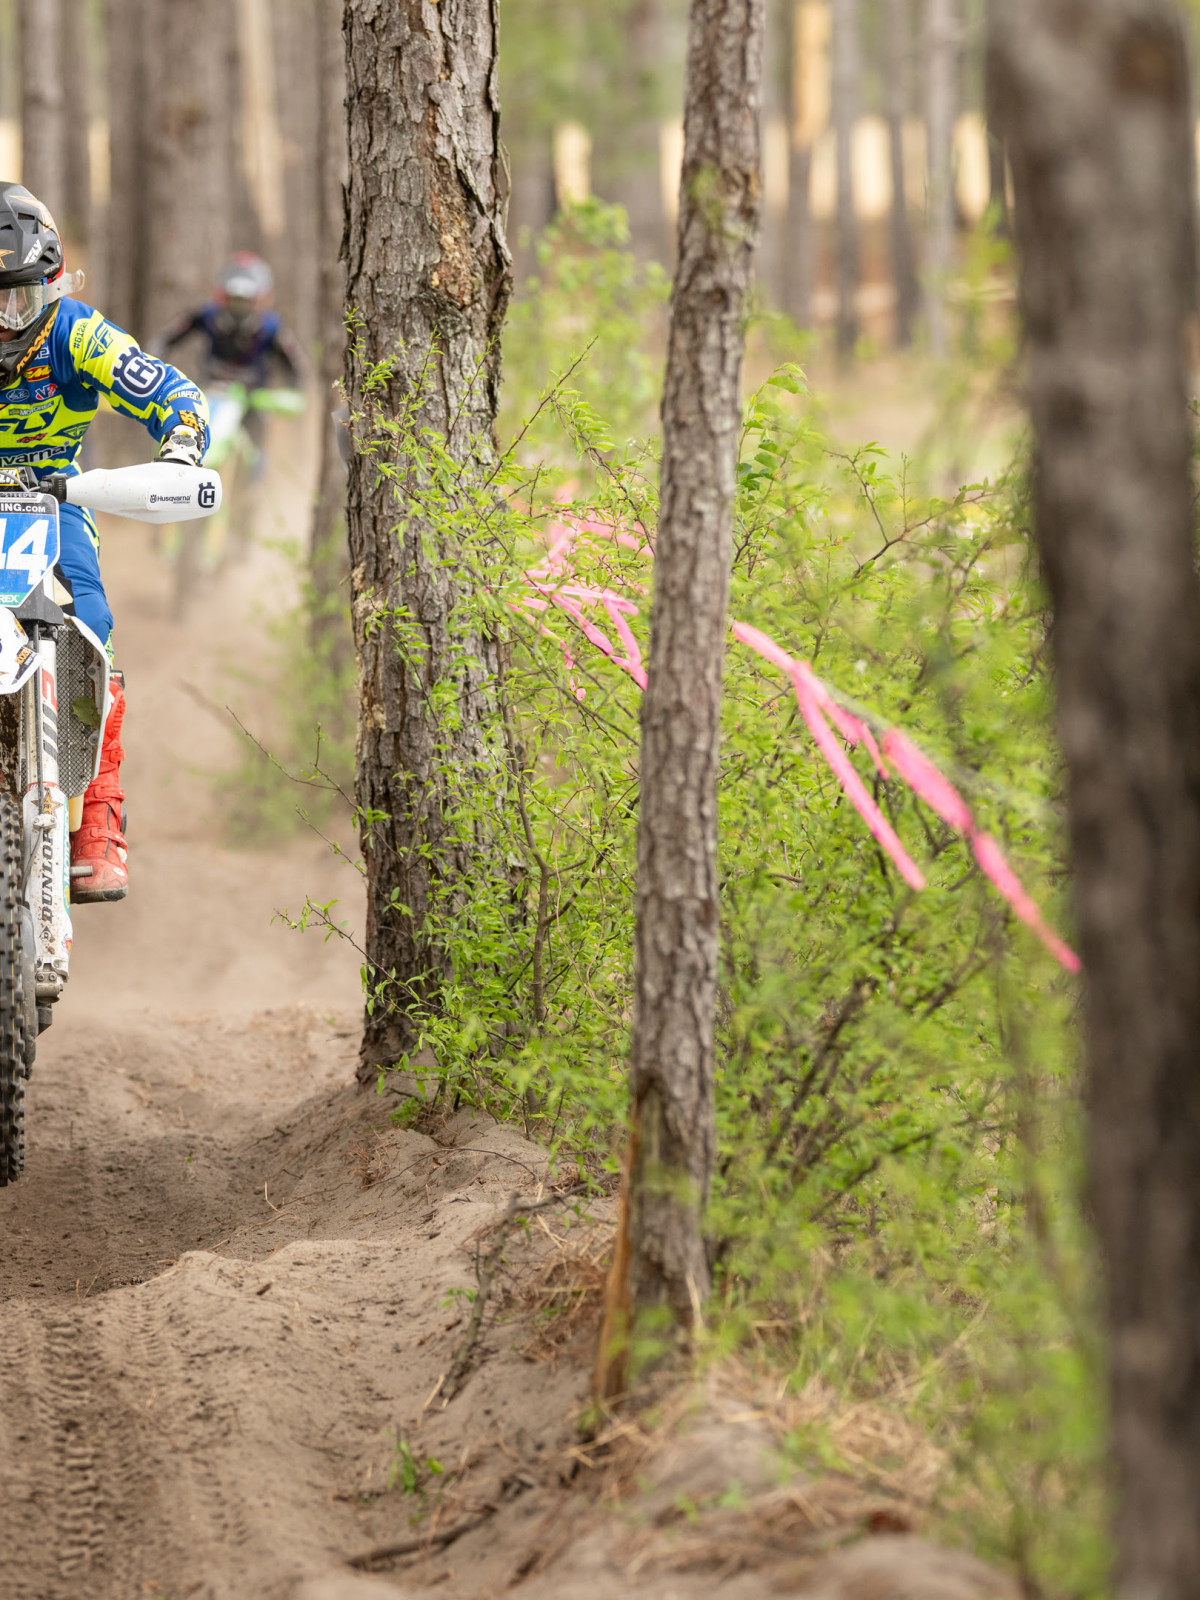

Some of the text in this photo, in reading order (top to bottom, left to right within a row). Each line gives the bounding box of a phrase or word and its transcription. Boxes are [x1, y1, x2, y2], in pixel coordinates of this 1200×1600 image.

[23, 239, 43, 265] FLY
[157, 495, 191, 503] Husqvarna
[41, 830, 54, 924] DUNLOP
